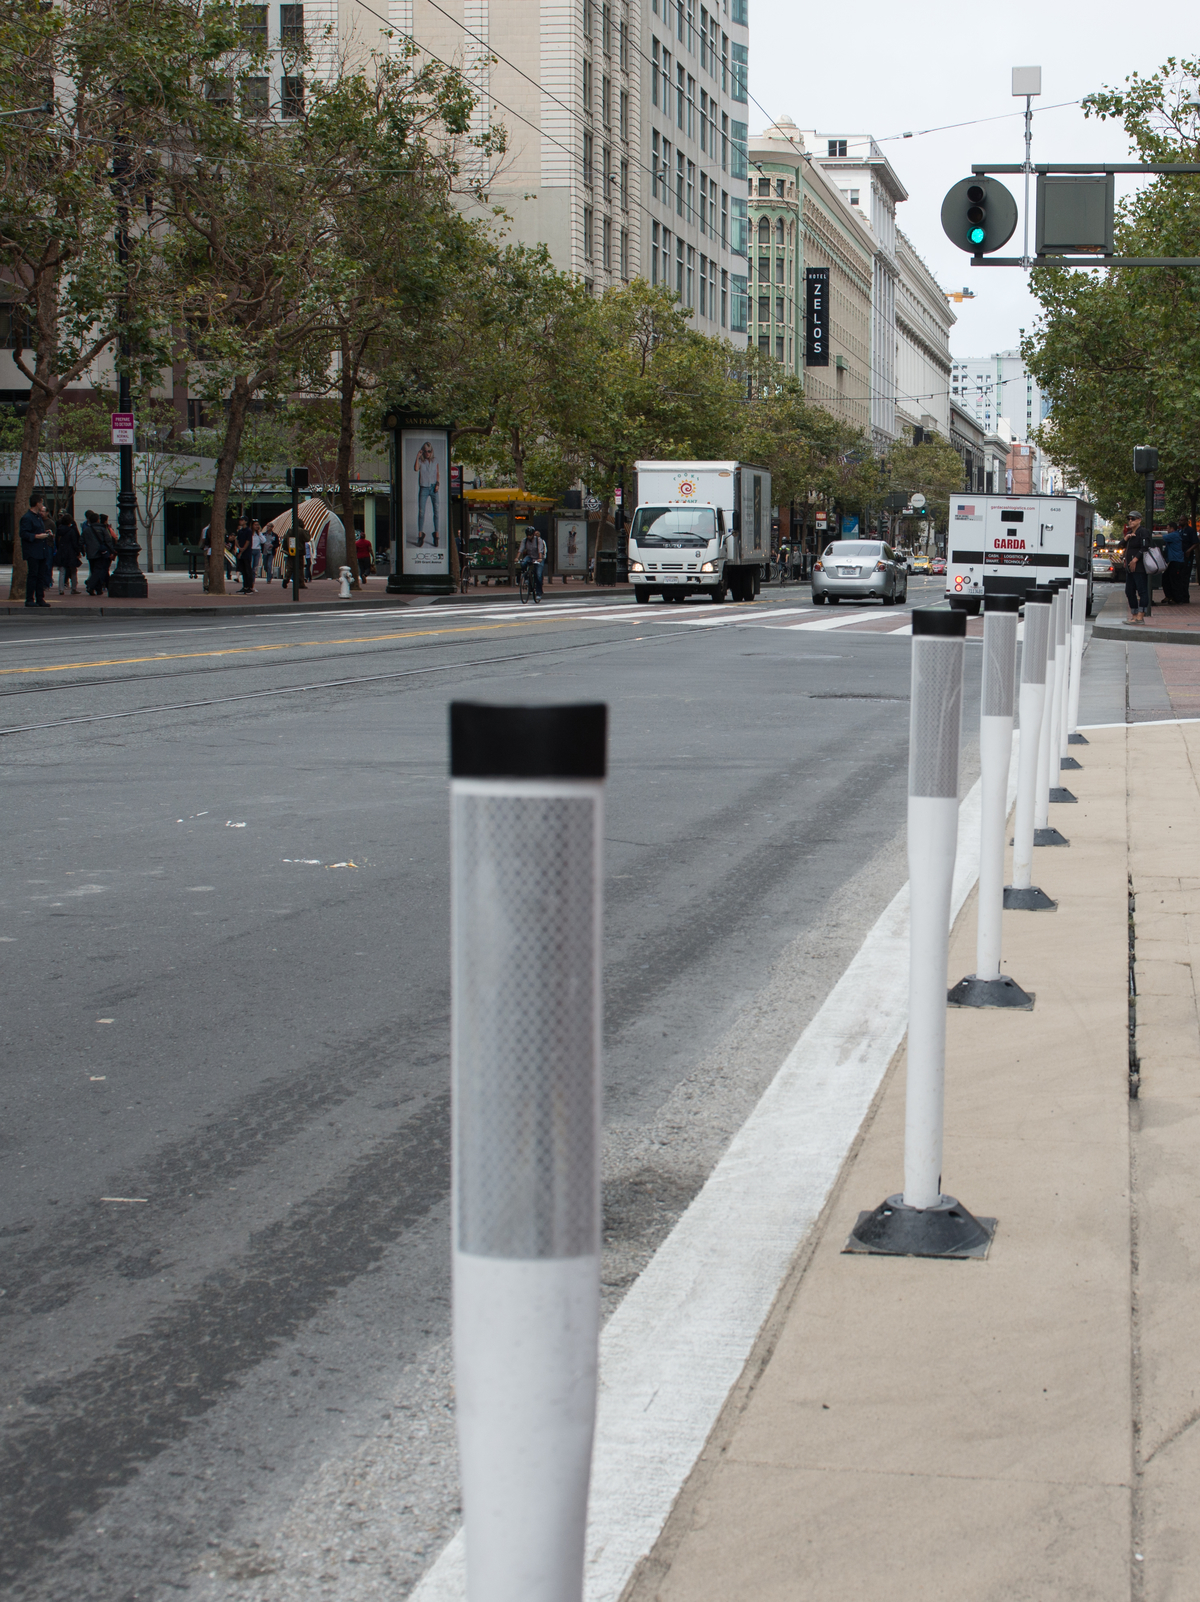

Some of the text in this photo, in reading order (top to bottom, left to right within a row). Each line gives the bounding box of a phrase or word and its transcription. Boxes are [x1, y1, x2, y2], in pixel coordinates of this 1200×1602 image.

[813, 283, 822, 354] ZELOS
[993, 538, 1026, 550] GARDA
[411, 552, 438, 560] JOE'S
[695, 550, 702, 558] 8
